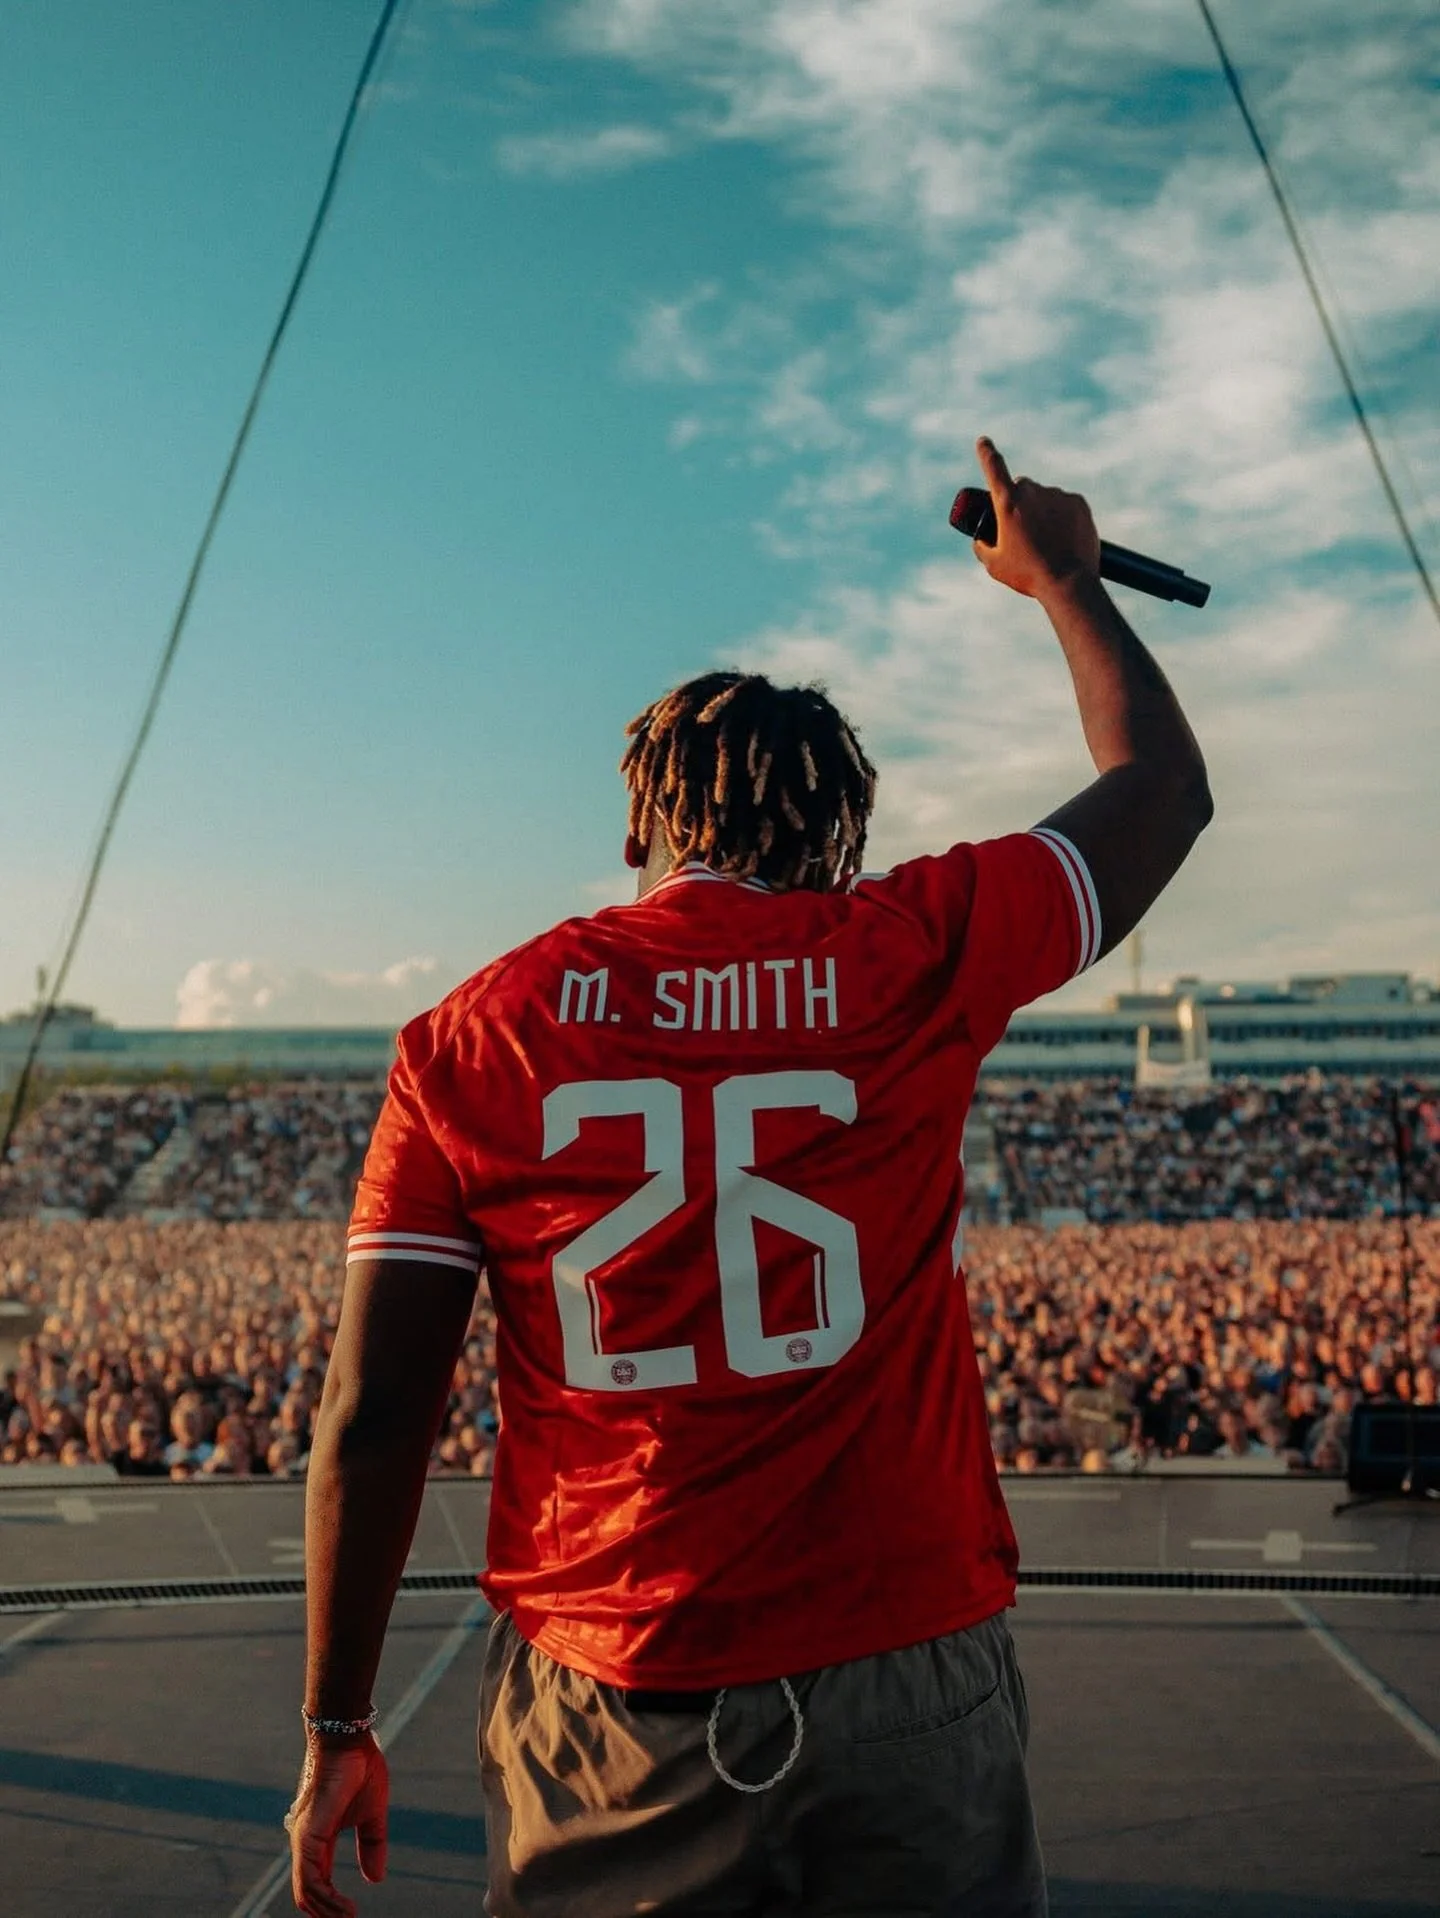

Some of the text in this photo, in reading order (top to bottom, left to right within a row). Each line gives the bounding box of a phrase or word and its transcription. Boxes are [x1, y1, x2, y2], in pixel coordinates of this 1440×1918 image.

[558, 957, 838, 1031] M. SMITH
[541, 1070, 866, 1392] 26
